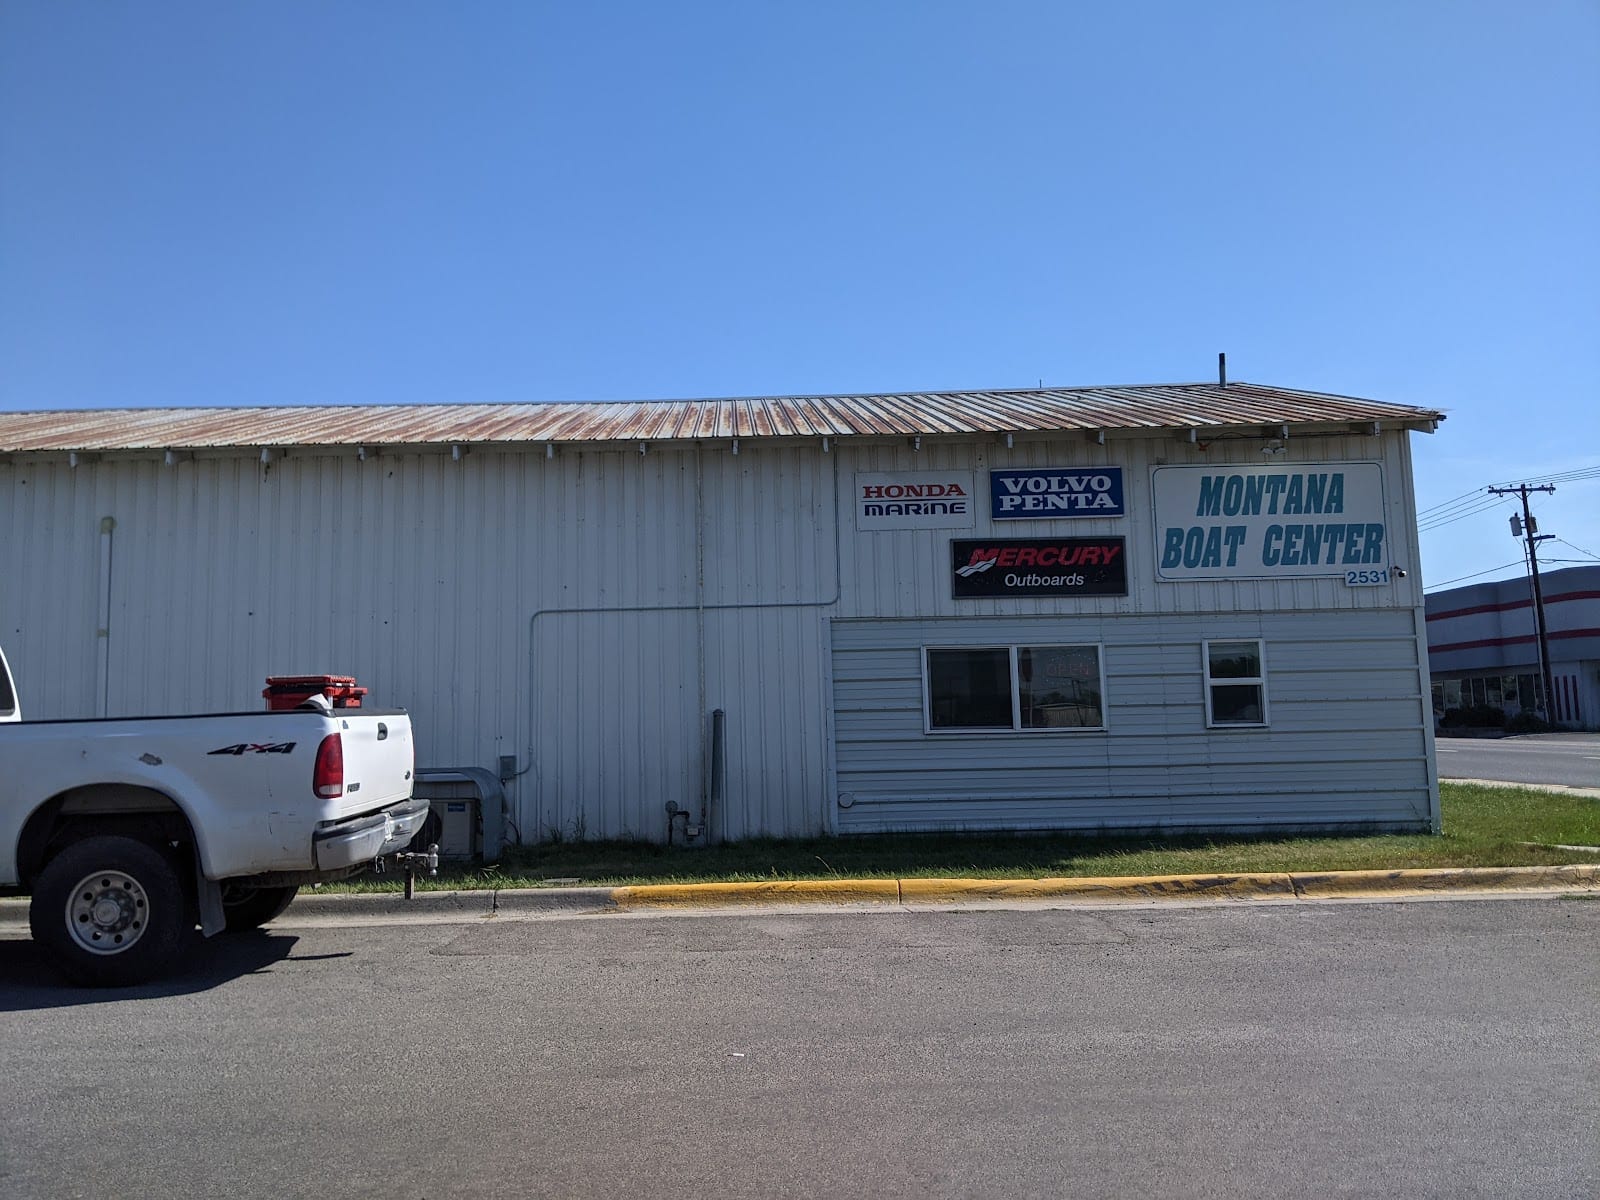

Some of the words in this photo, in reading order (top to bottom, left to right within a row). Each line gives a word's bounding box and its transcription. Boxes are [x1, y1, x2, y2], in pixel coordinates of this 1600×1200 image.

[862, 483, 967, 499] HONDA
[999, 474, 1112, 494] VOLVO
[999, 492, 1119, 511] PENTA
[1196, 472, 1345, 517] MONTANA
[864, 502, 967, 517] MARINE
[1160, 525, 1247, 569] BOAT
[1261, 523, 1384, 567] CENTER
[968, 545, 1121, 567] MERCURY
[1004, 572, 1085, 587] Outboards
[1347, 570, 1388, 585] 2531
